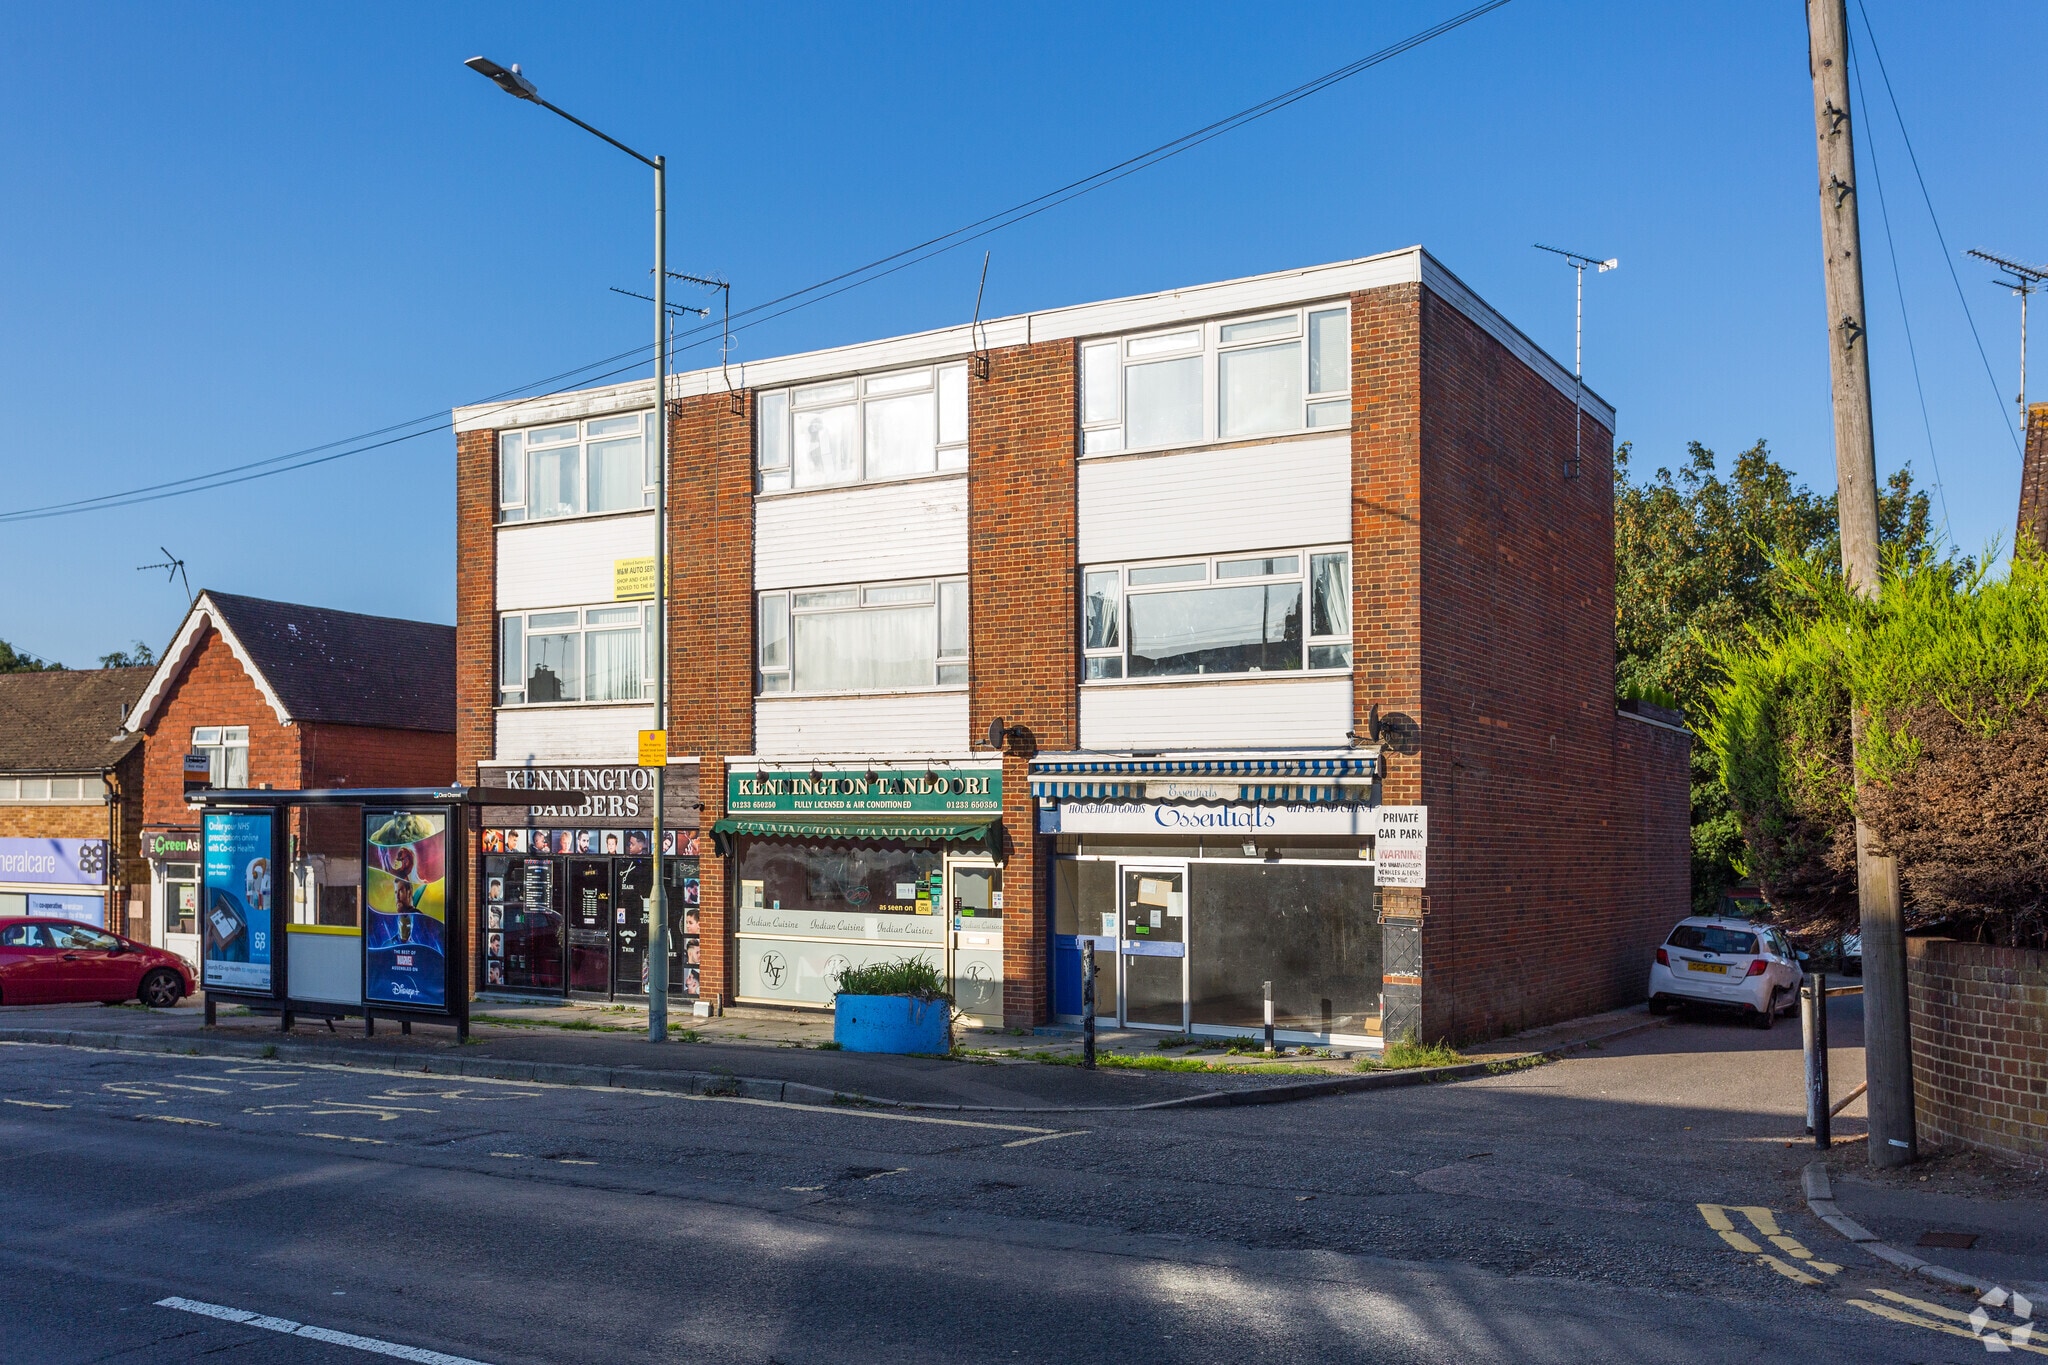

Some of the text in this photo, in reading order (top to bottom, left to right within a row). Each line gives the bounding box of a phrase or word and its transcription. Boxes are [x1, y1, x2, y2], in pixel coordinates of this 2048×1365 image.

[738, 777, 991, 795] KENNINGTON TANDOORI
[1168, 783, 1218, 798] Essentials
[866, 800, 912, 808] CONDITIONED
[1069, 797, 1373, 828] HOUSEHOLD GOODS Essentials GIFTS AND CHINA
[1383, 812, 1419, 823] PRIVATE
[208, 821, 250, 833] Order your NHS
[208, 833, 259, 843] prescriptions online
[1378, 828, 1424, 839] CAR PARK
[208, 843, 256, 854] with Co-op Health
[1379, 849, 1422, 860] WARNING
[746, 915, 799, 929] Indian Cuisine
[810, 918, 865, 932] Indian Cuisine
[877, 921, 934, 935] Indian Cuisine
